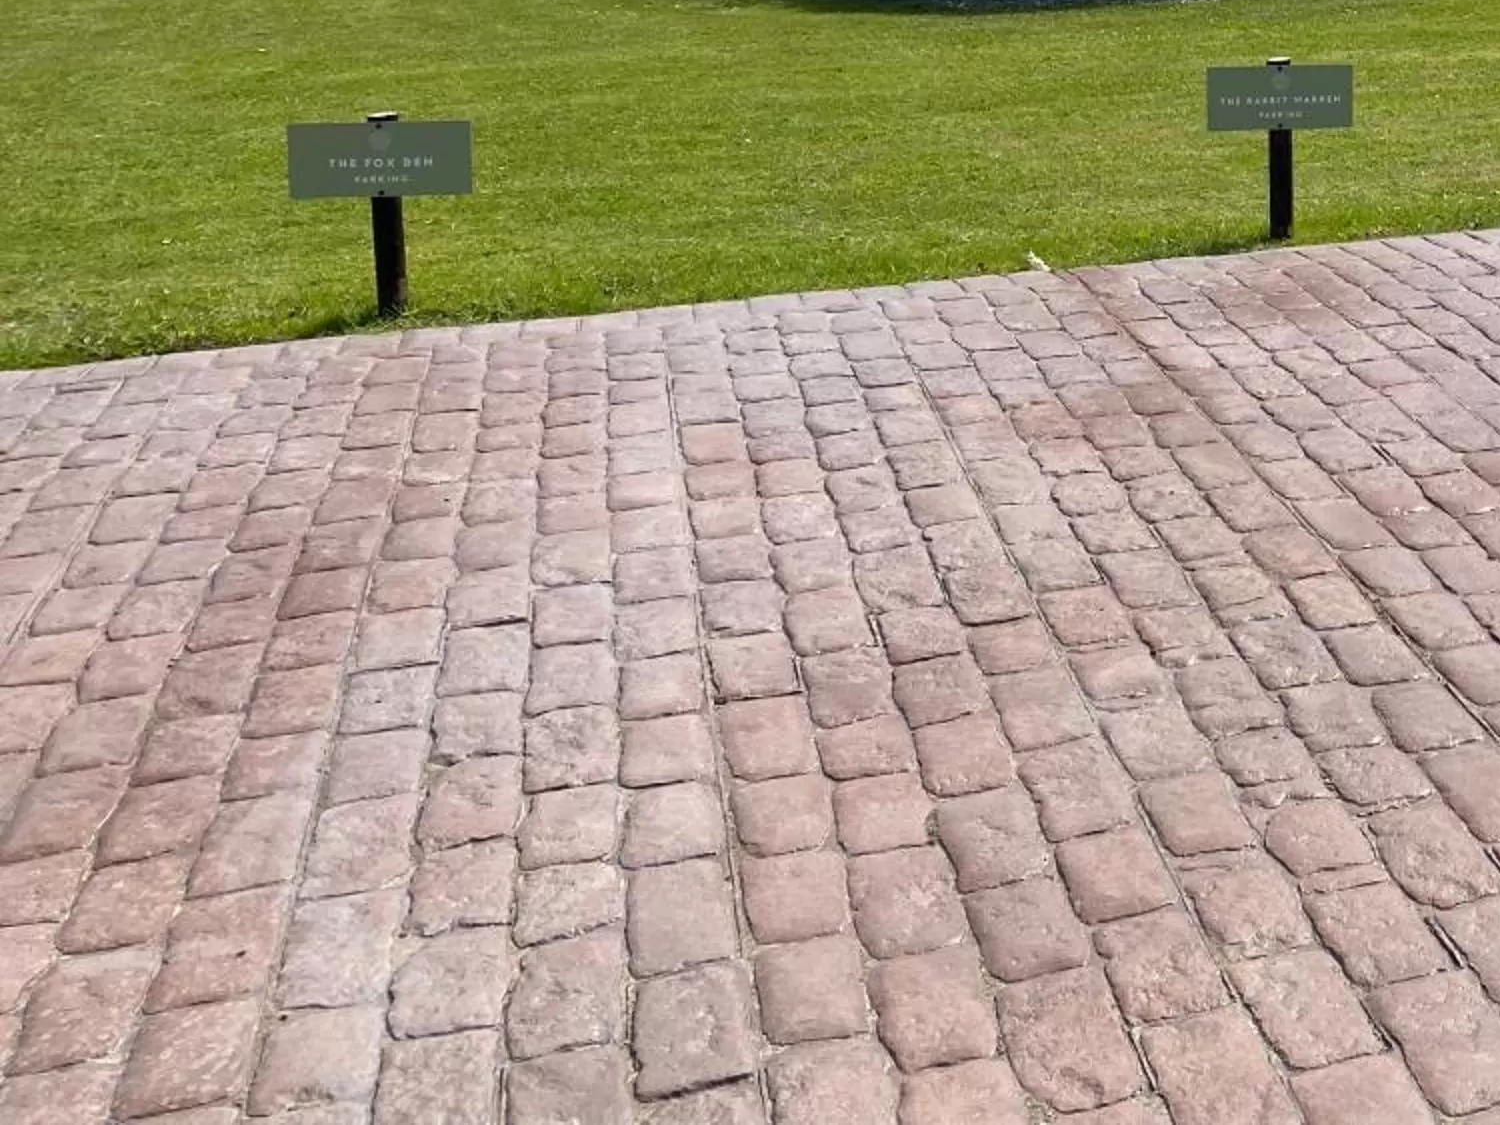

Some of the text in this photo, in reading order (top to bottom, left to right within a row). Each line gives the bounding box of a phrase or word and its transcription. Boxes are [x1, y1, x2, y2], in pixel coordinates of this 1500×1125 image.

[1220, 97, 1240, 106] THE
[328, 155, 433, 169] THE FOX DEN
